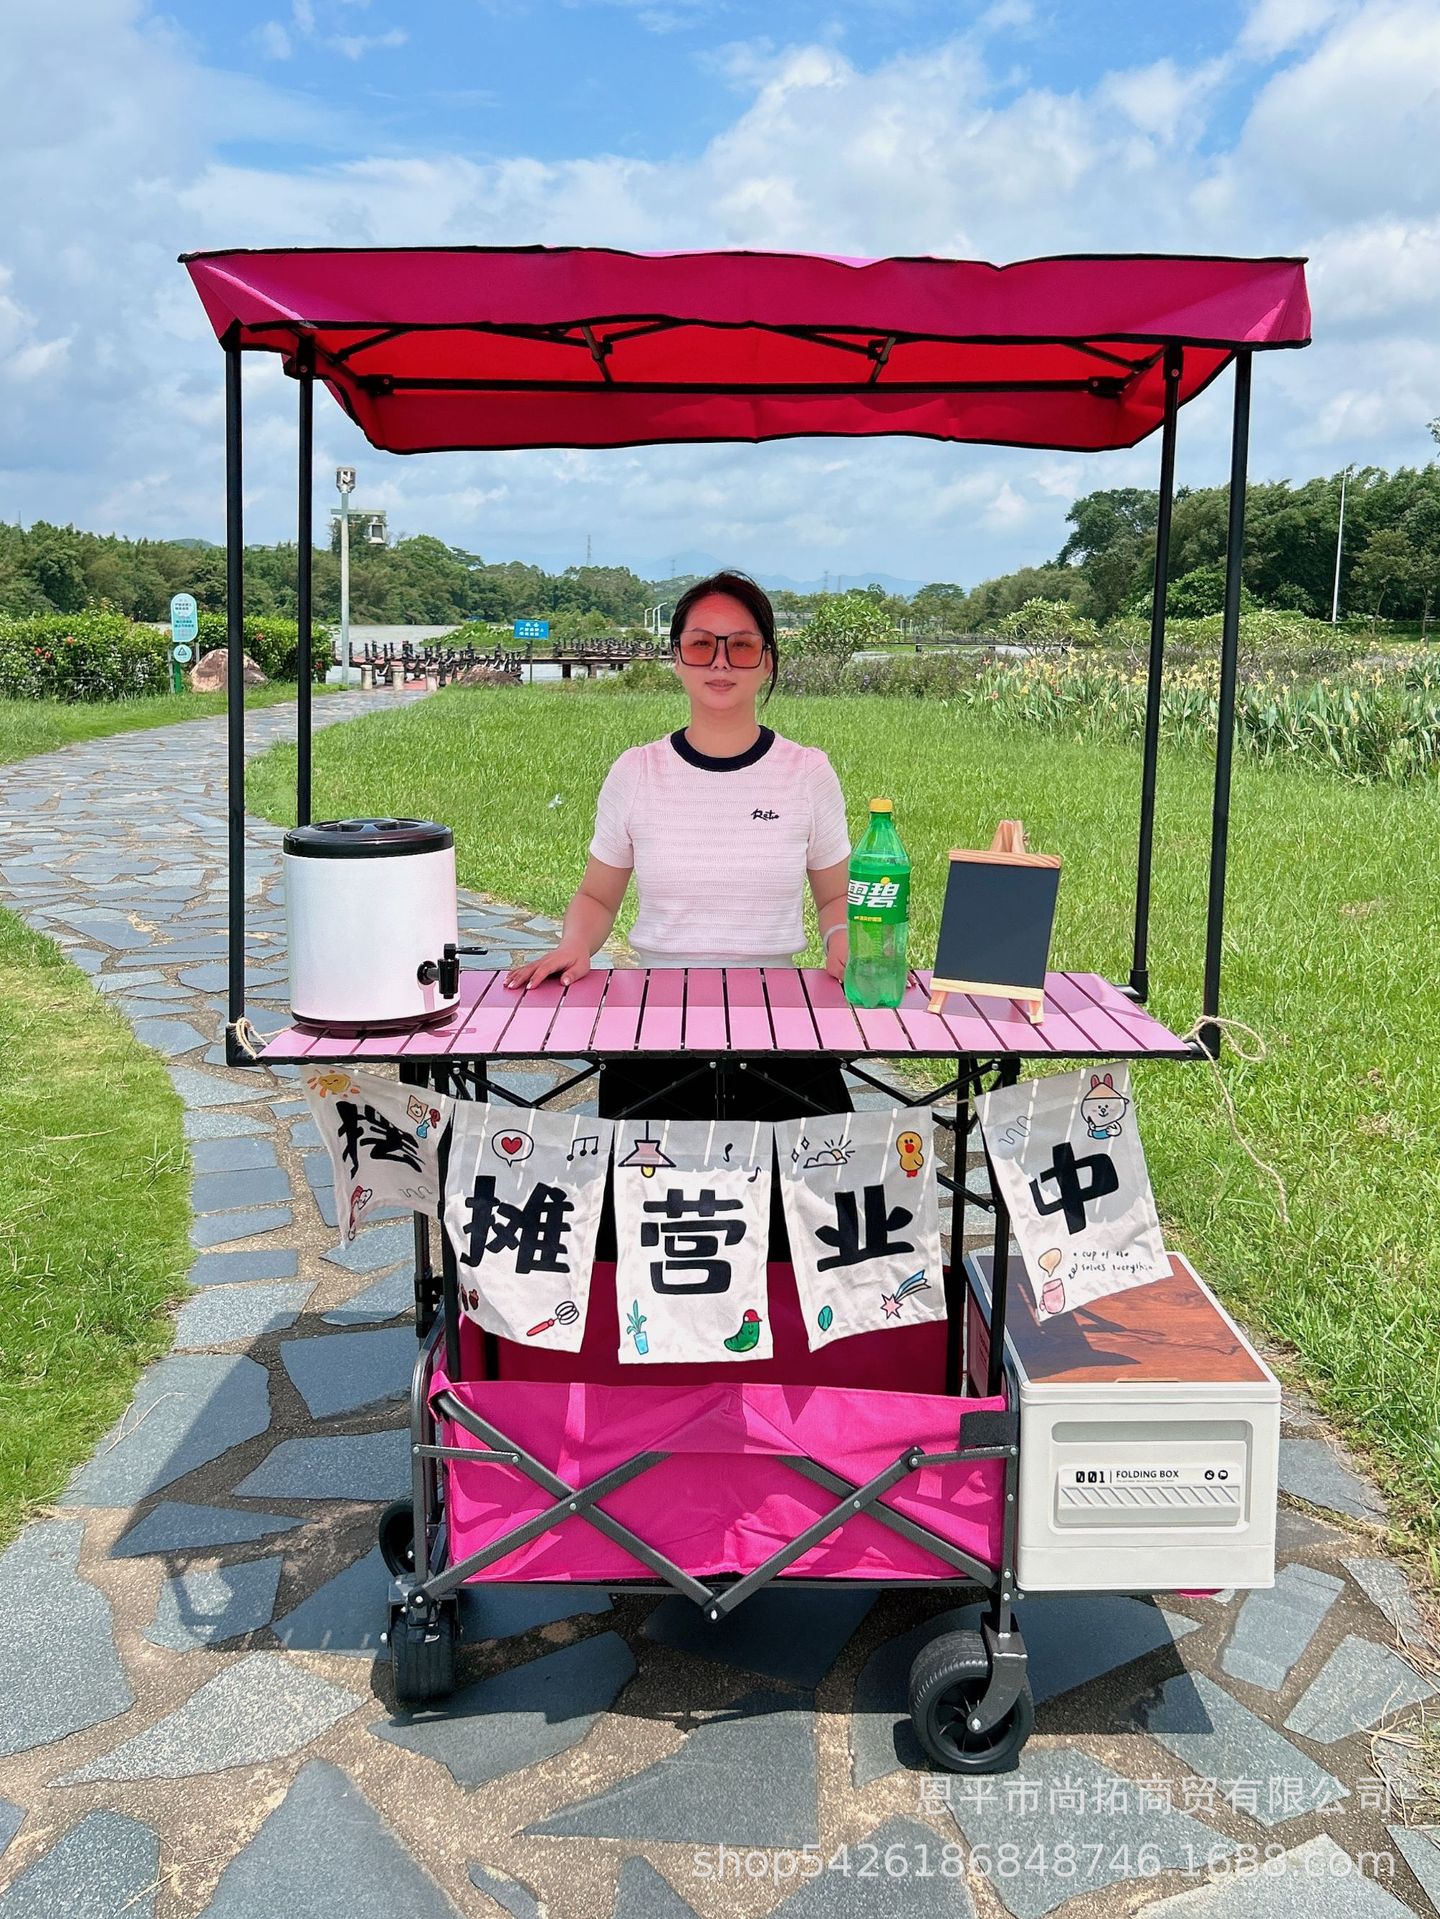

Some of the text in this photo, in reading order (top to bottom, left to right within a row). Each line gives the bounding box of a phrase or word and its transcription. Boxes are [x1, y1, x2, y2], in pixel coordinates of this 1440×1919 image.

[847, 879, 900, 908] 雪碧
[459, 1174, 575, 1274] 摊
[640, 1188, 747, 1295] 营
[814, 1183, 915, 1273] 业
[1028, 1141, 1120, 1236] 中
[1075, 1470, 1179, 1483] 001 FOLDING BOX
